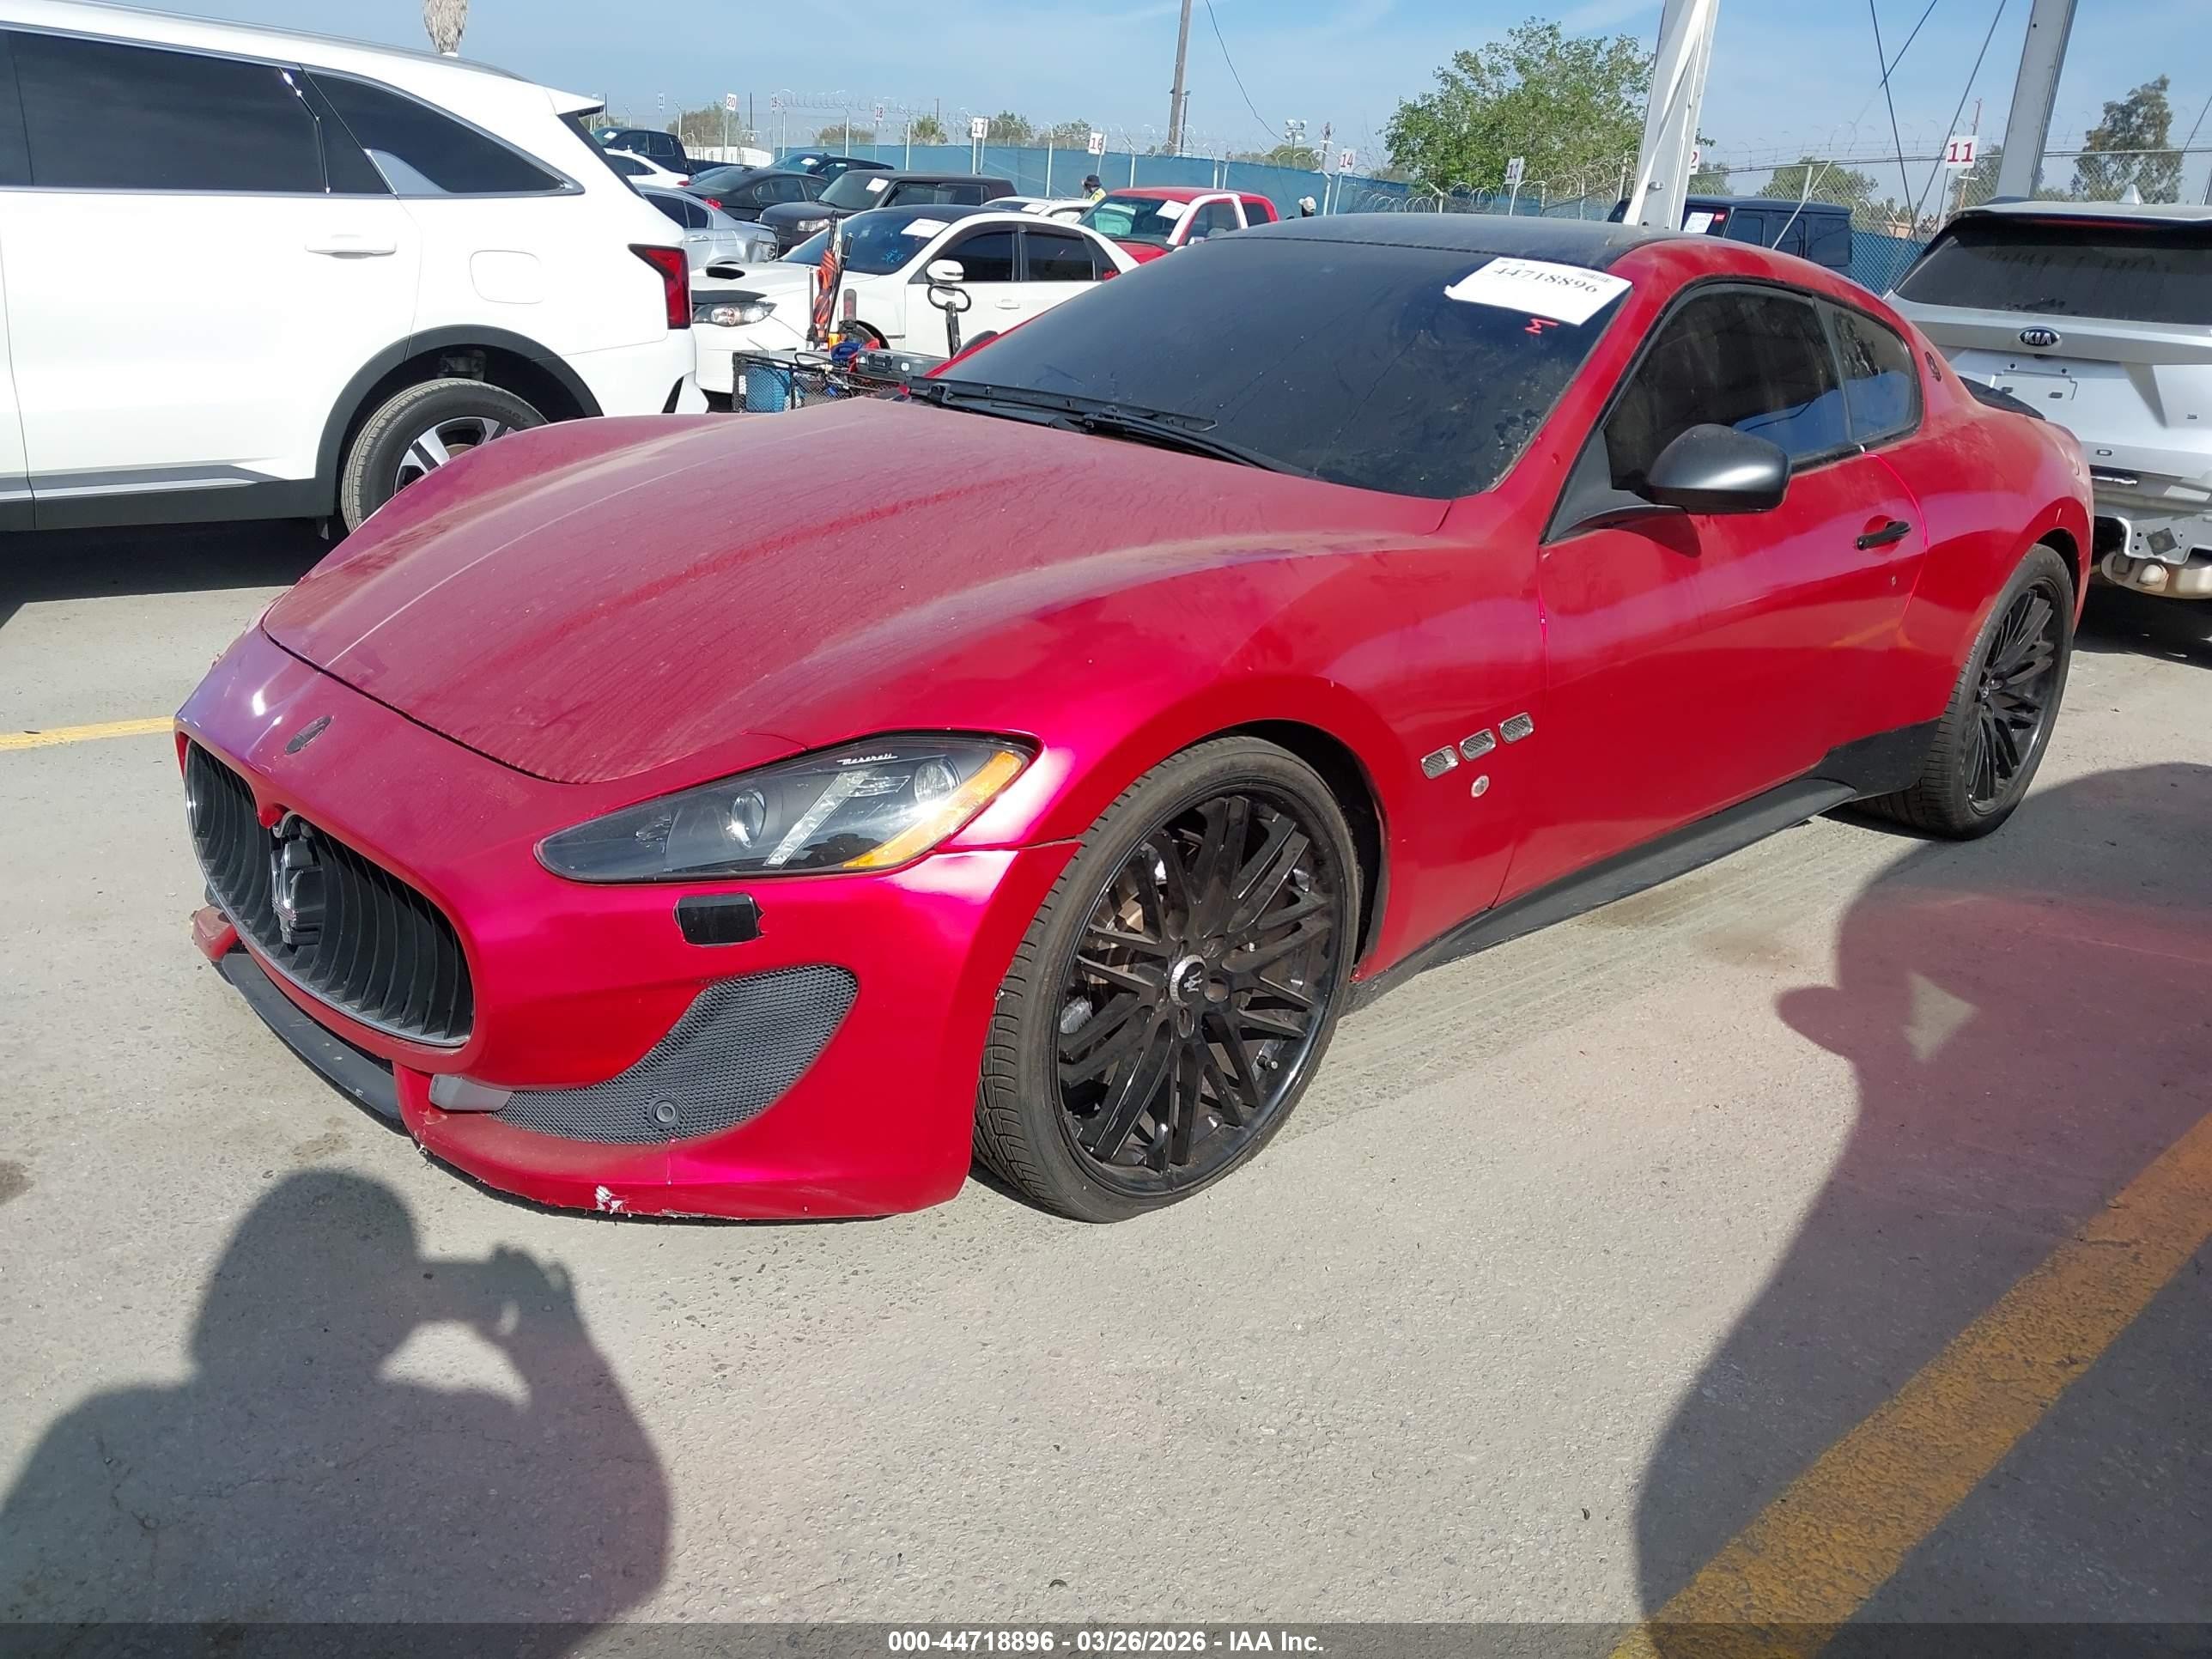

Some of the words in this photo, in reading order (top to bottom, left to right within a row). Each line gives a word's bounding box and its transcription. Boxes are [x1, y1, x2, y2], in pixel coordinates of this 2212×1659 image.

[726, 95, 736, 108] 20
[875, 106, 884, 118] 18
[1947, 142, 1973, 162] 11
[1340, 152, 1354, 168] 14
[1492, 267, 1598, 293] 44718896
[2024, 331, 2051, 344] KIA
[836, 753, 898, 765] Maserati
